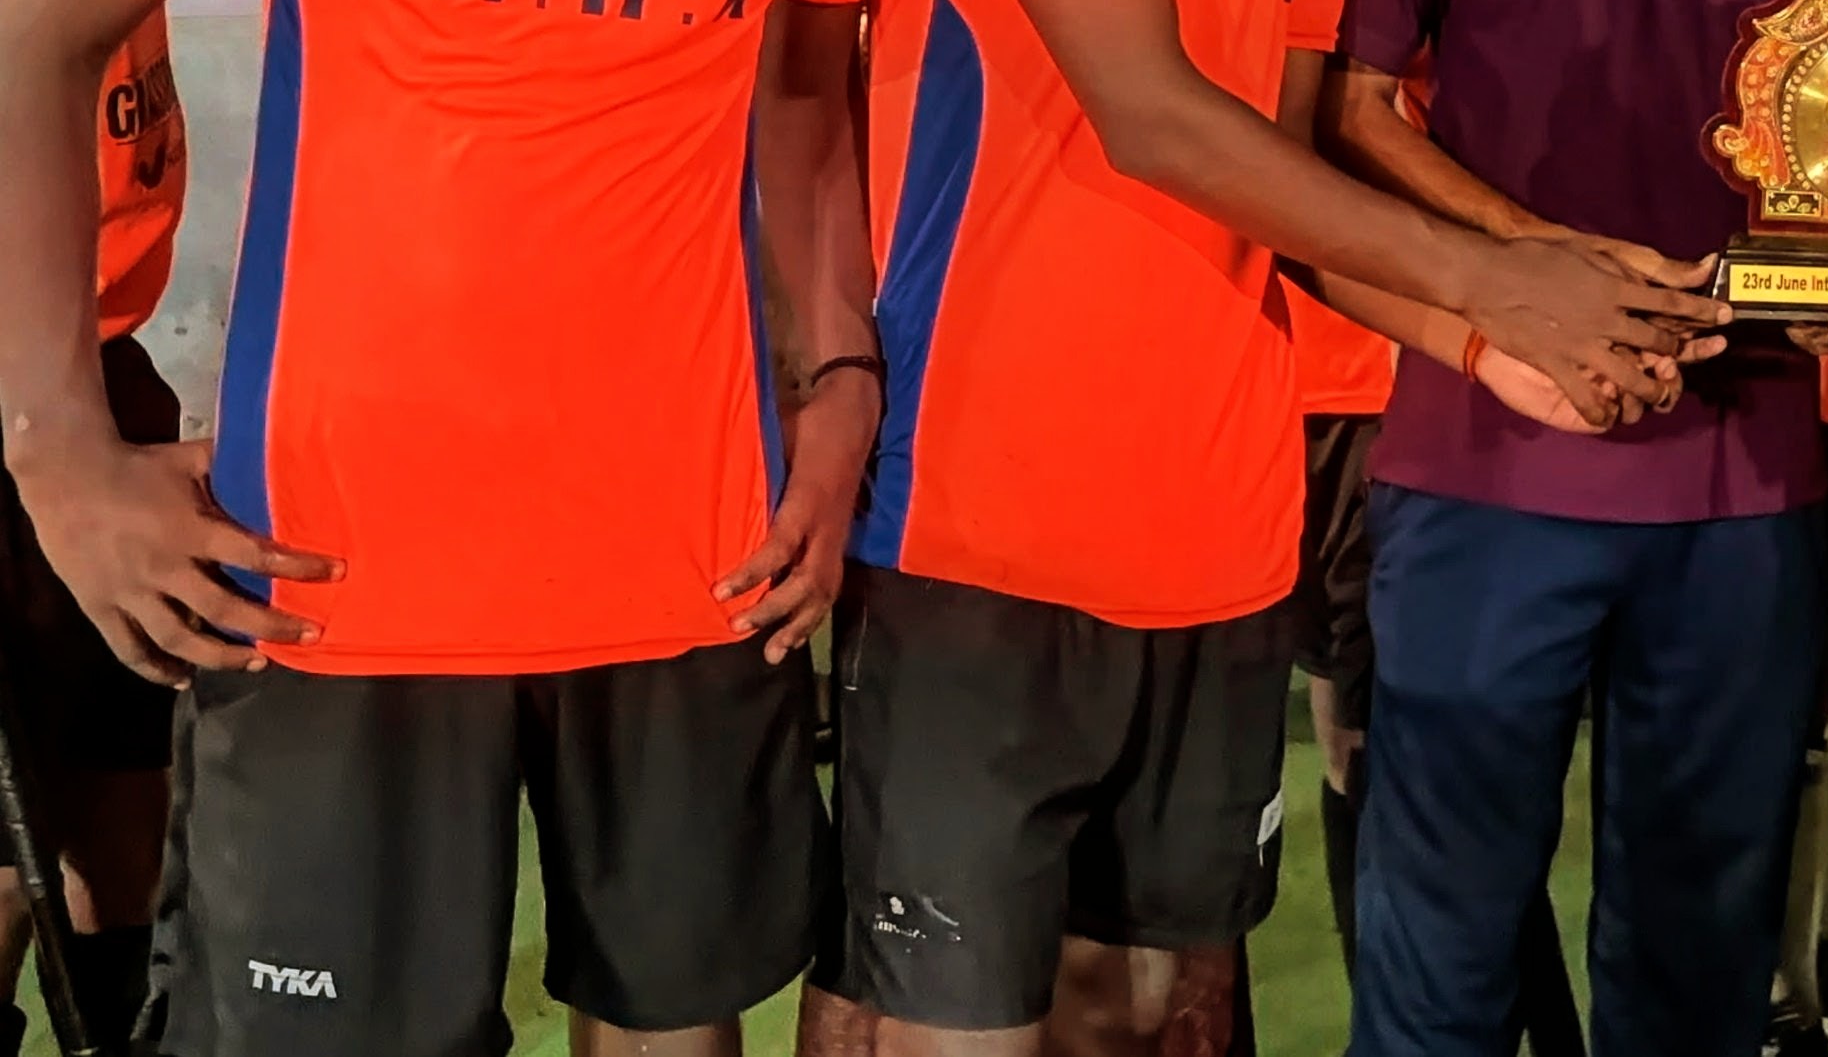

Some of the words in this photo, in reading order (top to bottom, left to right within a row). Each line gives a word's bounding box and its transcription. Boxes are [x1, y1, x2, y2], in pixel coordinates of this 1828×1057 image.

[1742, 273, 1772, 290] 23rd
[1775, 274, 1808, 292] June
[248, 959, 338, 999] TYKA
